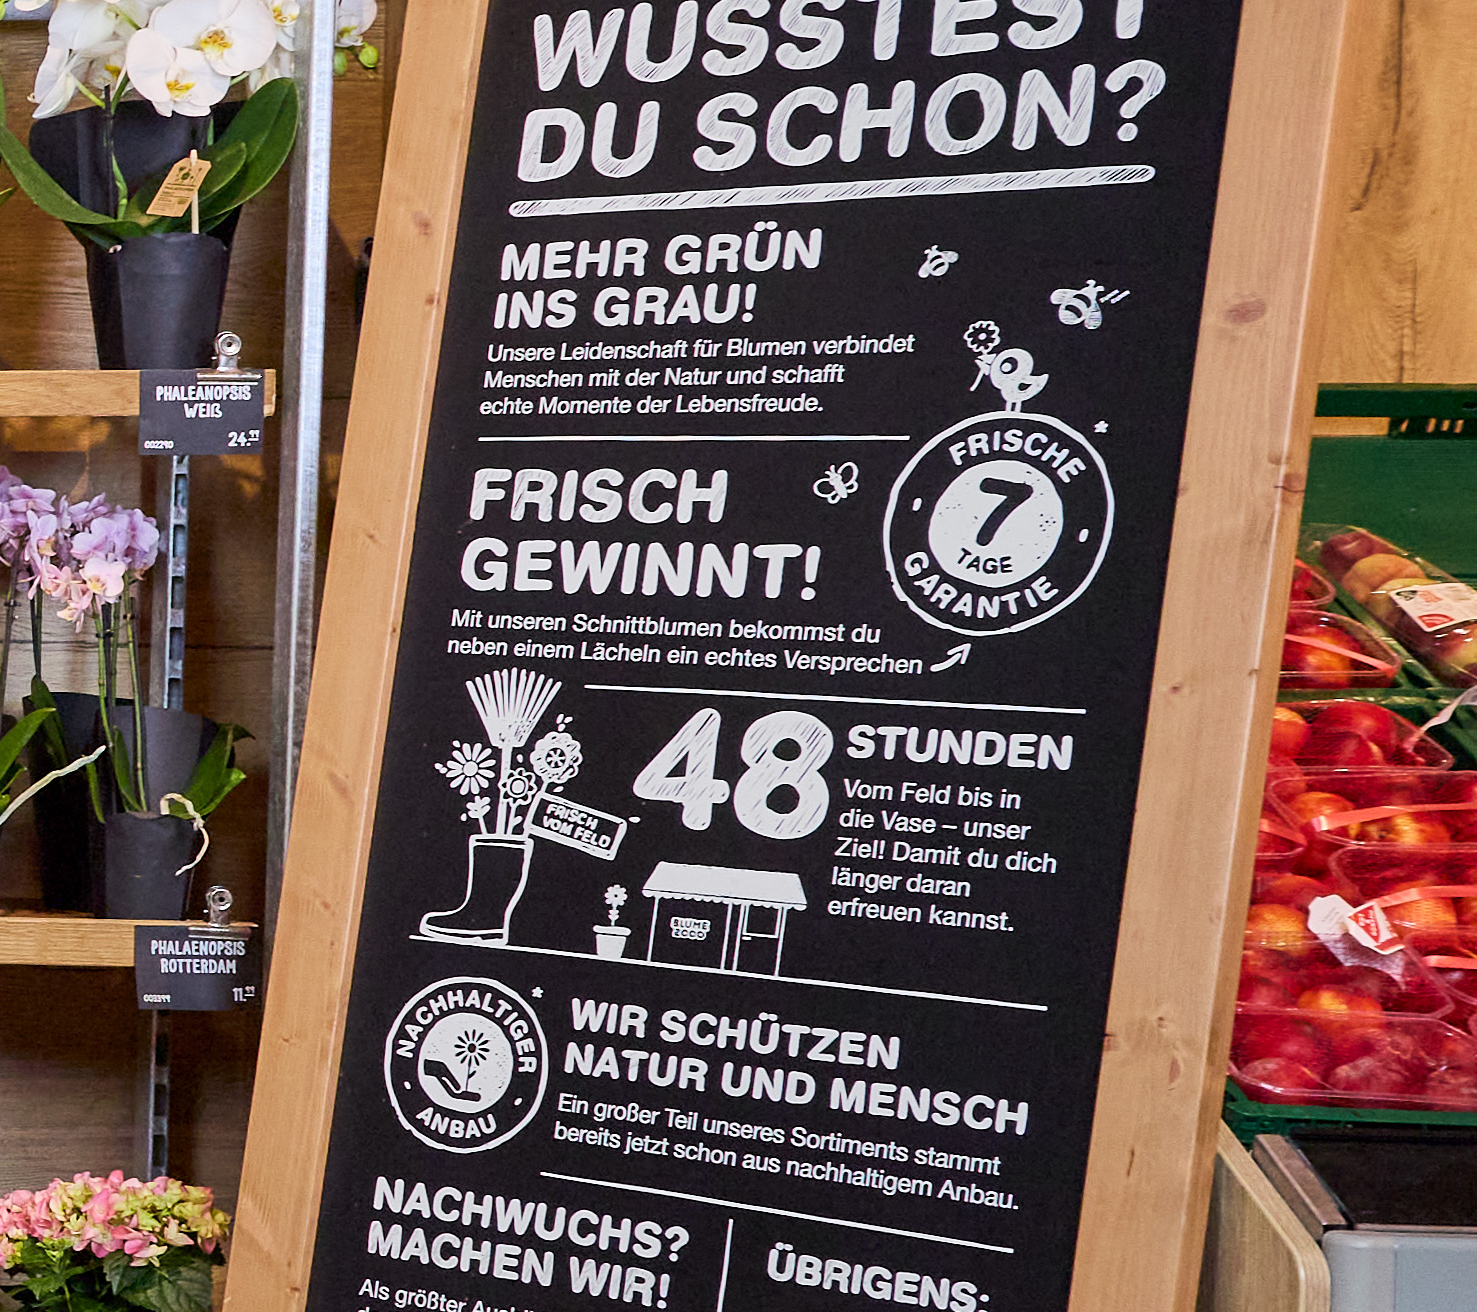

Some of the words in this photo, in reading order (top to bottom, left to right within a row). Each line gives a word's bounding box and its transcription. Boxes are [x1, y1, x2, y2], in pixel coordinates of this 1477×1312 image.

[516, 100, 660, 182] DU
[691, 58, 1166, 175] SCHON?
[499, 237, 649, 281] MEHR
[663, 218, 822, 275] GRÜN
[492, 288, 578, 329] INS
[592, 282, 757, 327] GRAU!
[486, 343, 555, 362] Unsere
[559, 339, 688, 361] Leidenschaft
[692, 337, 722, 357] für
[726, 337, 806, 357] Blumen
[812, 333, 915, 354] verbindet
[155, 385, 252, 401] PHALEANOPSIS
[482, 369, 583, 388] Menschen
[587, 368, 621, 386] mit
[624, 367, 660, 386] der
[663, 366, 722, 385] Natur
[725, 364, 767, 384] und
[770, 363, 845, 384] schafft
[479, 396, 533, 414] echte
[537, 395, 632, 414] Momente
[635, 394, 672, 413] der
[675, 392, 823, 413] Lebensfreude.
[948, 428, 1086, 483] FRISCHE
[468, 467, 728, 523] FRISCH
[979, 477, 1034, 547] 7
[460, 536, 821, 601] GEWINNT!
[957, 547, 1013, 574] TAGE
[904, 551, 1059, 619] GARANTIE
[845, 723, 1073, 770] STUNDEN
[632, 707, 835, 840] 48
[843, 777, 893, 801] Vom
[899, 781, 951, 804] Feld
[956, 785, 993, 807] bis
[999, 787, 1021, 809] in
[542, 816, 571, 841] VOM
[573, 825, 612, 851] FELD
[546, 802, 599, 830] FRISCH
[830, 865, 902, 894] länger
[905, 872, 971, 897] daran
[672, 917, 710, 932] BLUME
[673, 927, 707, 940] 2000
[826, 897, 921, 922] erfreuen
[928, 903, 1013, 932] kannst.
[150, 939, 245, 956] PHALAENOPSIS
[160, 957, 237, 974] ROTTERDAM
[396, 988, 538, 1074] NACHHALTIGER
[571, 997, 648, 1038] WIR
[659, 1009, 900, 1070] SCHÜTZEN
[563, 1041, 708, 1092] NATUR
[720, 1061, 816, 1104] UND
[829, 1077, 1028, 1135] MENSCH
[416, 1106, 497, 1139] ANBAU
[372, 1175, 689, 1262] NACHWUCHS?
[367, 1219, 554, 1287] MACHEN
[568, 1255, 670, 1309] WIR!
